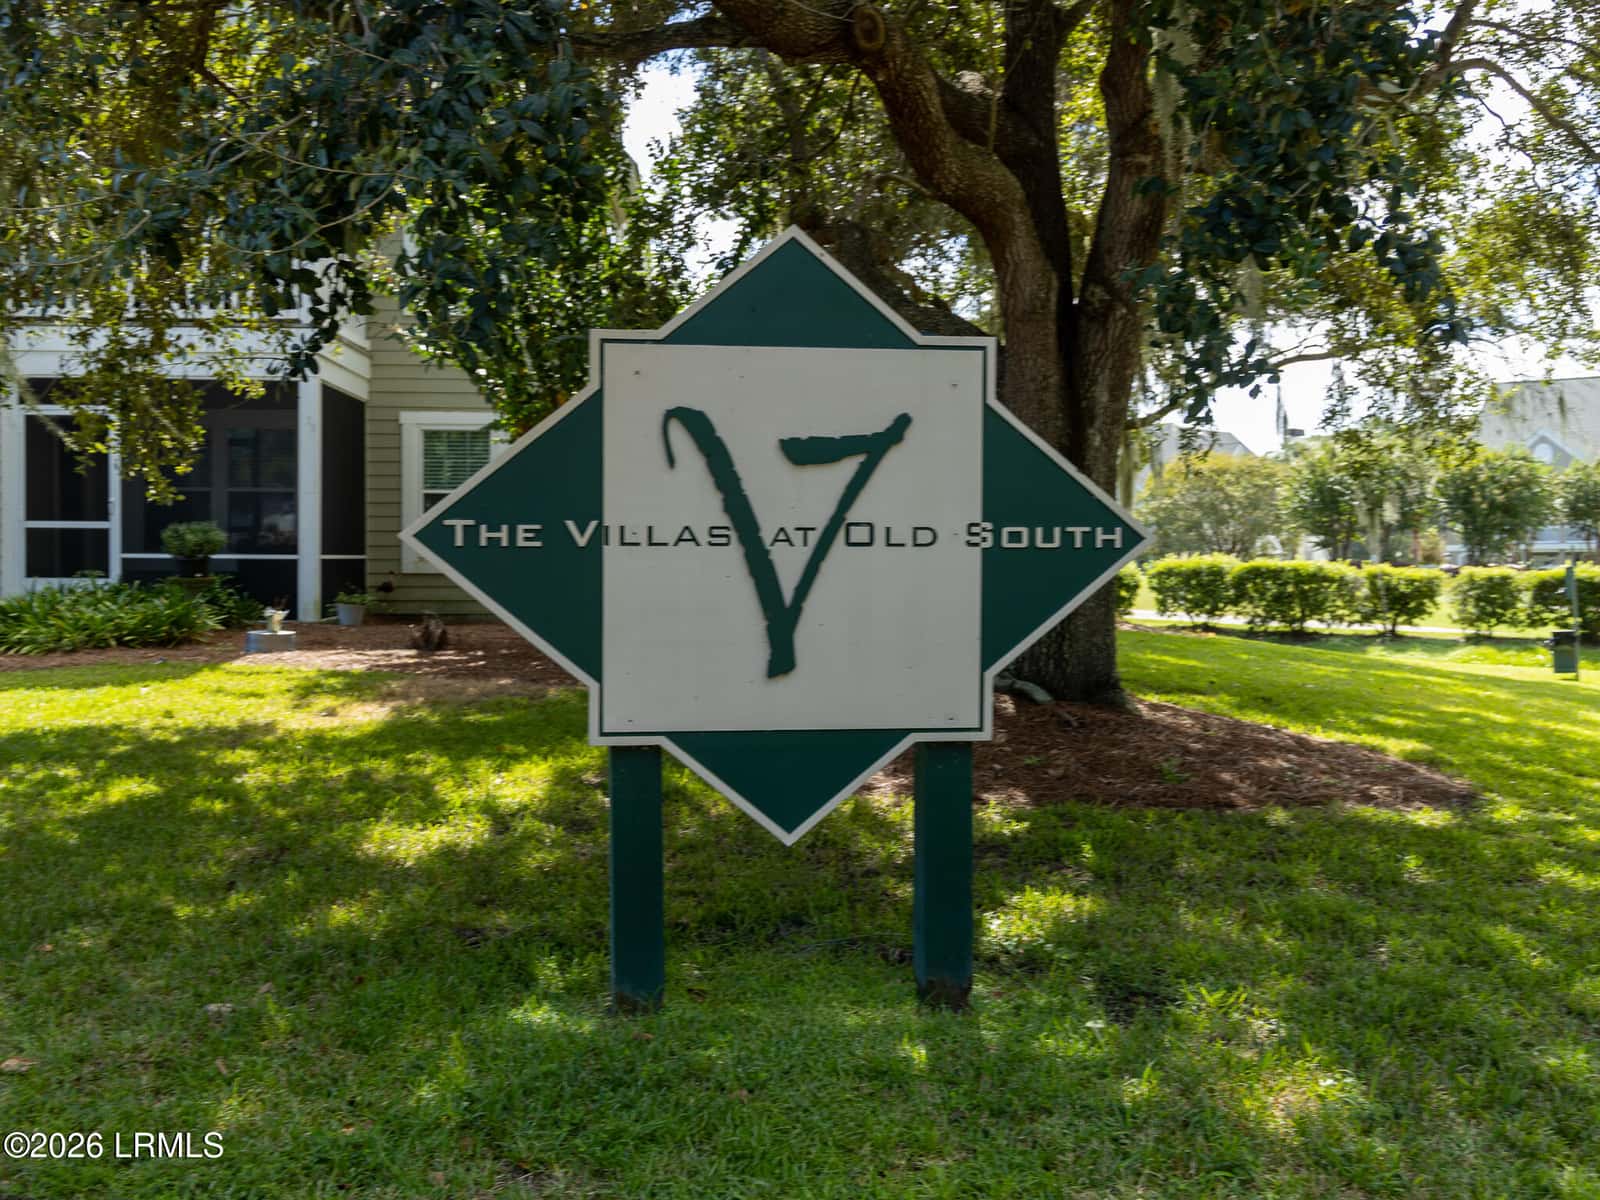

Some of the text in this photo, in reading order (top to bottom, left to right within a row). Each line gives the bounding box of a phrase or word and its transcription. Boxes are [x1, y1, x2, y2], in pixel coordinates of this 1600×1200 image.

[443, 519, 1124, 549] THE VILLAS AT OLD SOUTH
